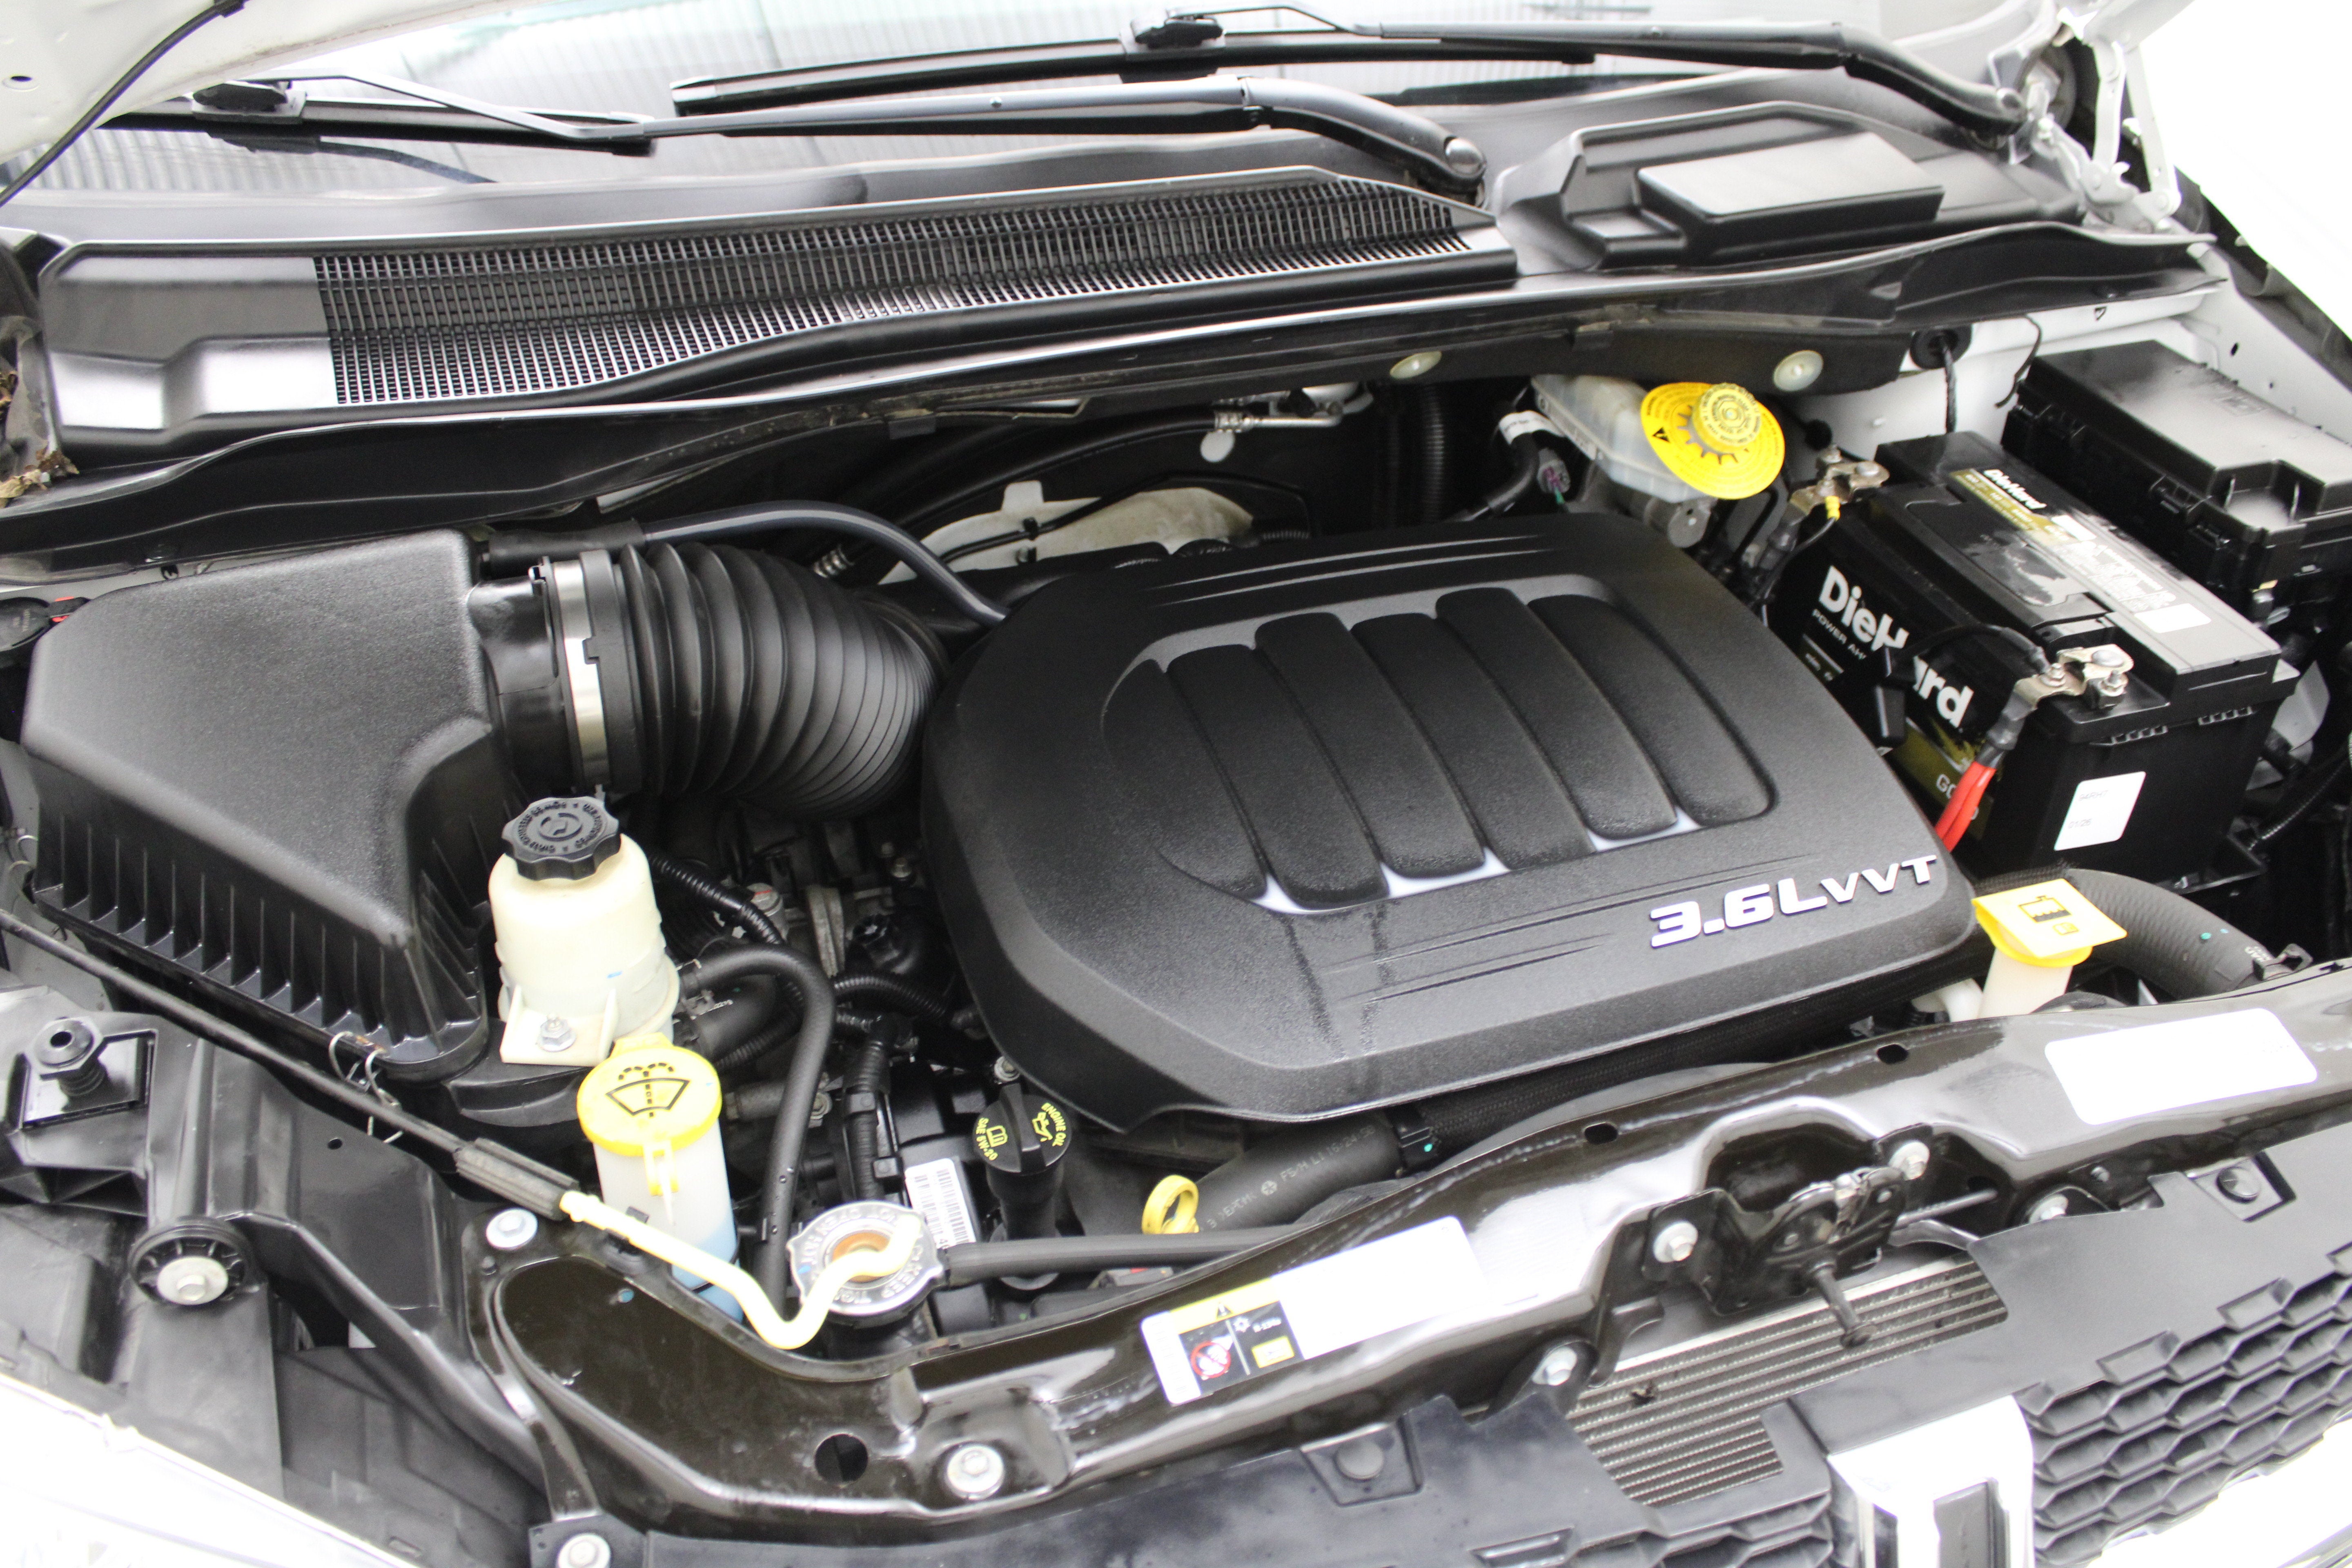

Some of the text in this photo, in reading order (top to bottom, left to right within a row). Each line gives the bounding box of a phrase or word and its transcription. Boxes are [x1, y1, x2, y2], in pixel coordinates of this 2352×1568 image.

[1812, 609, 1848, 644] POWER
[976, 1117, 998, 1161] SAE 5W-20
[1041, 1102, 1067, 1147] ENGINE OIL
